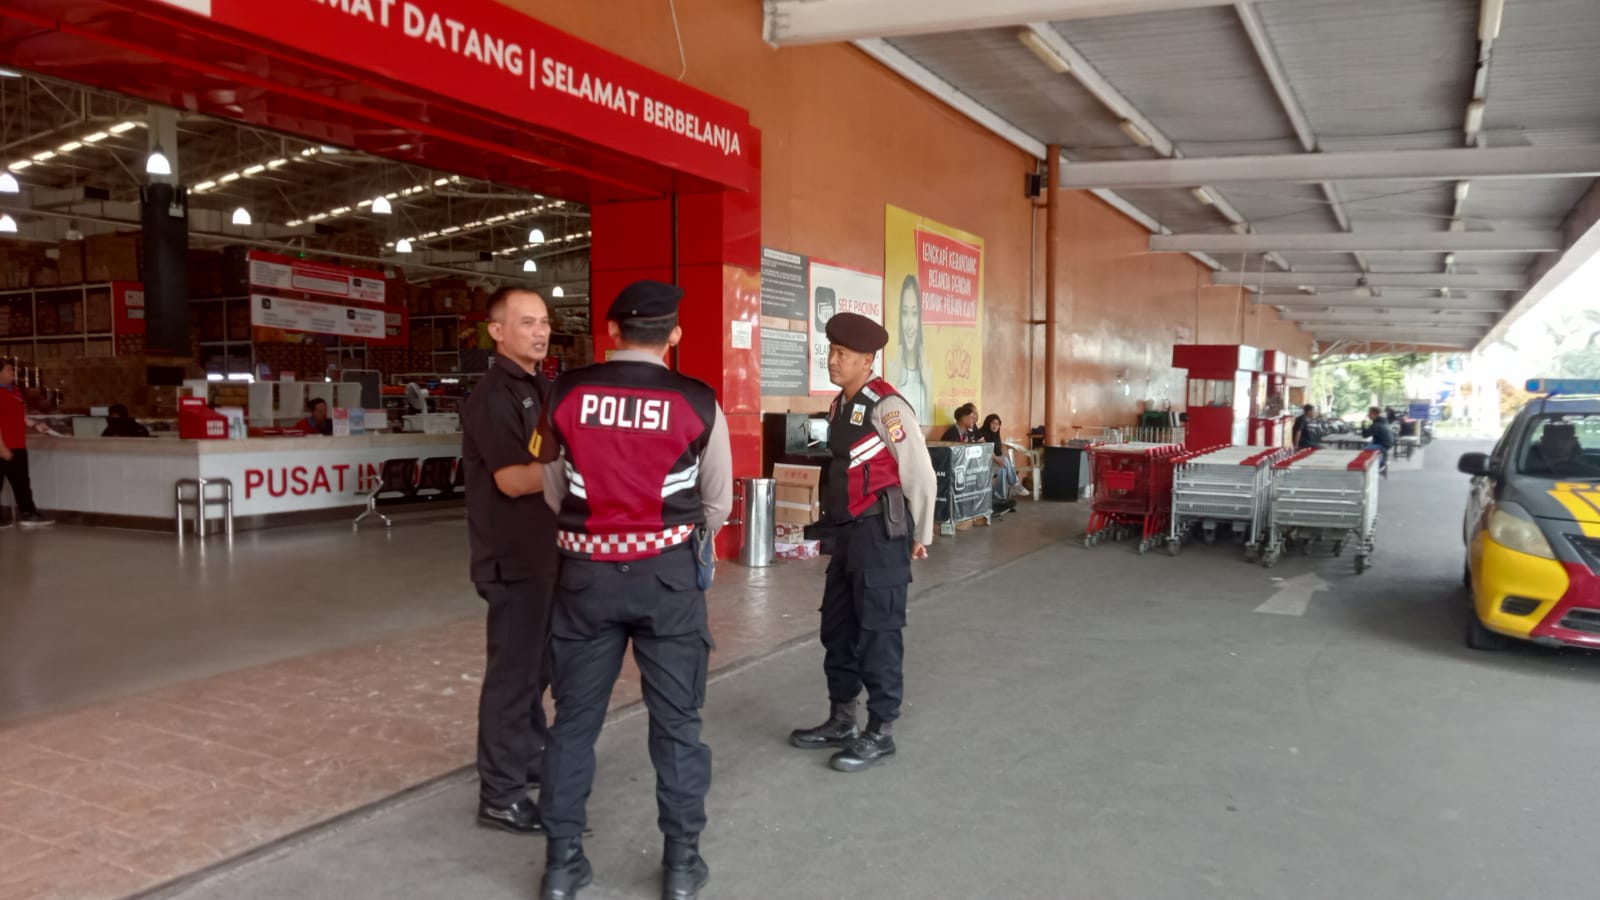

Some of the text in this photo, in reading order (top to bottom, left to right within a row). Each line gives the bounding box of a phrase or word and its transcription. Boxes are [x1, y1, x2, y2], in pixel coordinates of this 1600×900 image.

[403, 1, 523, 76] DATANG
[541, 56, 640, 118] SELAMAT
[643, 96, 742, 156] BERBELANJA
[838, 297, 880, 317] SELF PACKING
[580, 393, 670, 431] POLISI
[244, 463, 350, 499] PUSAT
